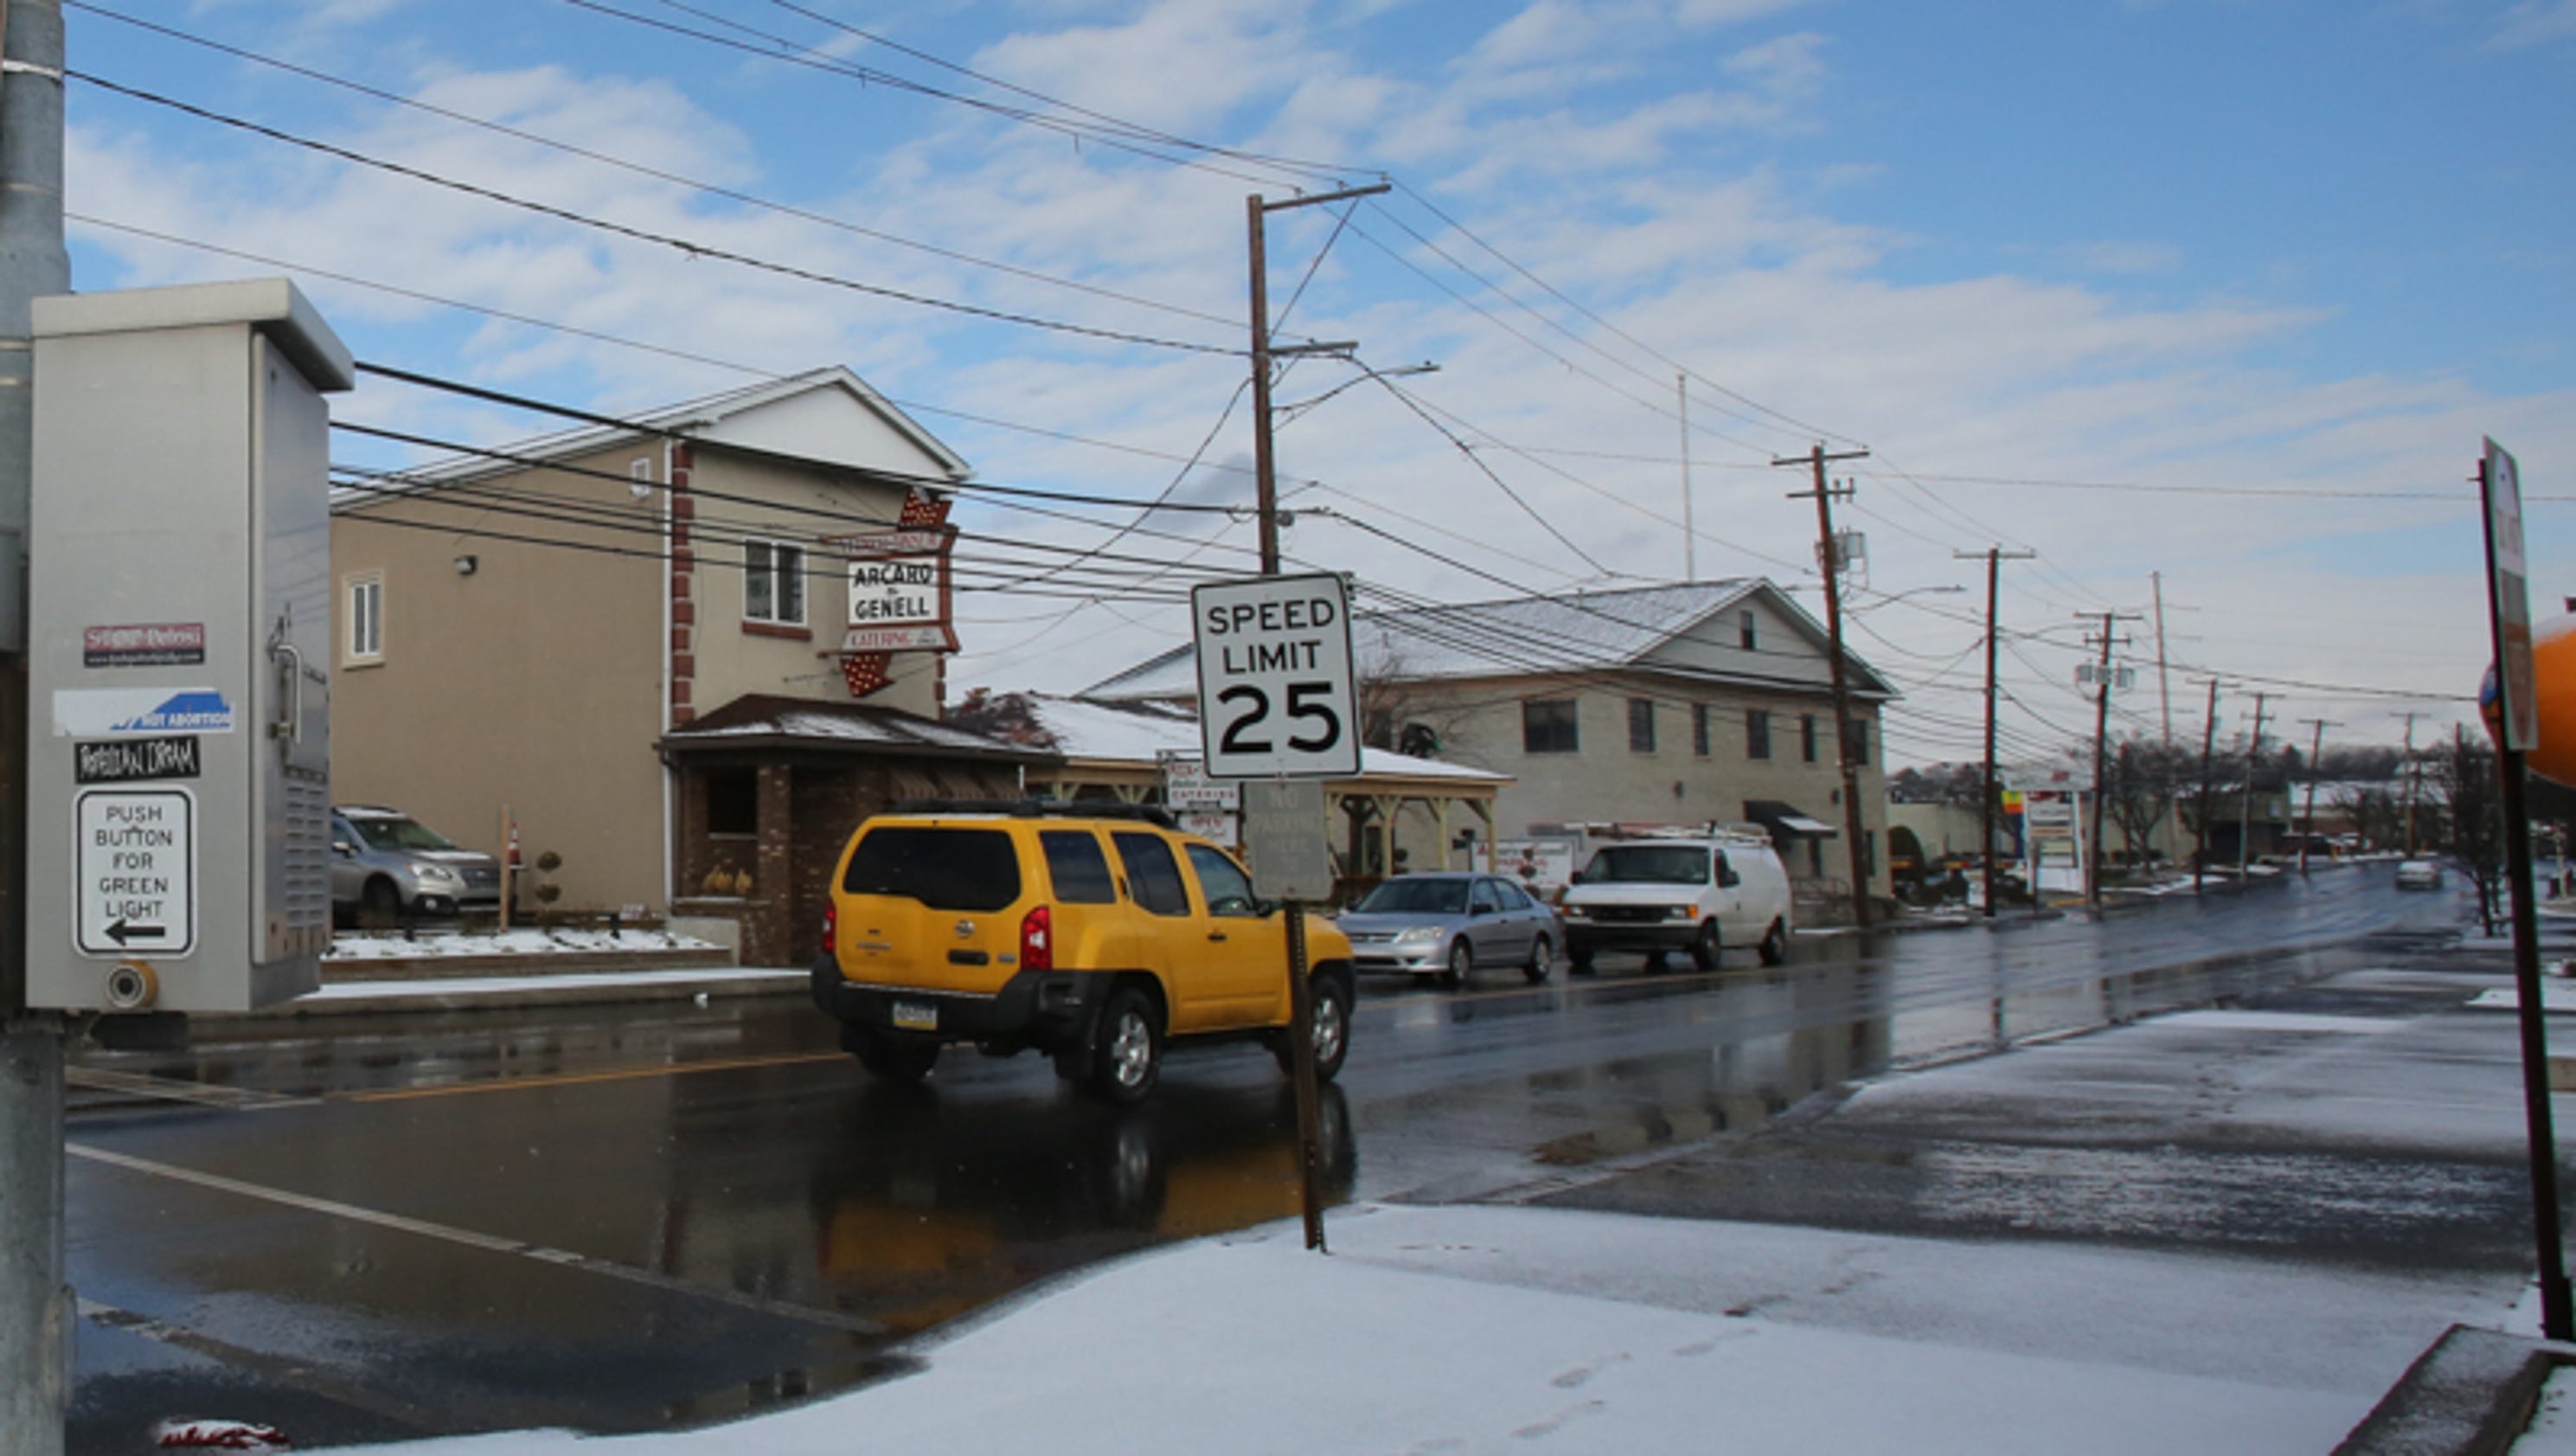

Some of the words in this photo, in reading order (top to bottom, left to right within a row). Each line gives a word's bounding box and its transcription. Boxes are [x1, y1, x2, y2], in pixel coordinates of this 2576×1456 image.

[855, 562, 932, 586] ARCARO
[855, 597, 930, 619] GENELL
[1208, 600, 1334, 634] SPEED
[851, 631, 914, 646] CATERING
[1223, 639, 1322, 674] LIMIT
[1217, 682, 1340, 754] 25
[1269, 788, 1299, 808] NO
[106, 805, 163, 823] PUSH
[95, 827, 172, 846] BUTTON
[112, 852, 153, 869] FOR
[99, 876, 168, 895] GREEN
[106, 900, 163, 918] LIGHT
